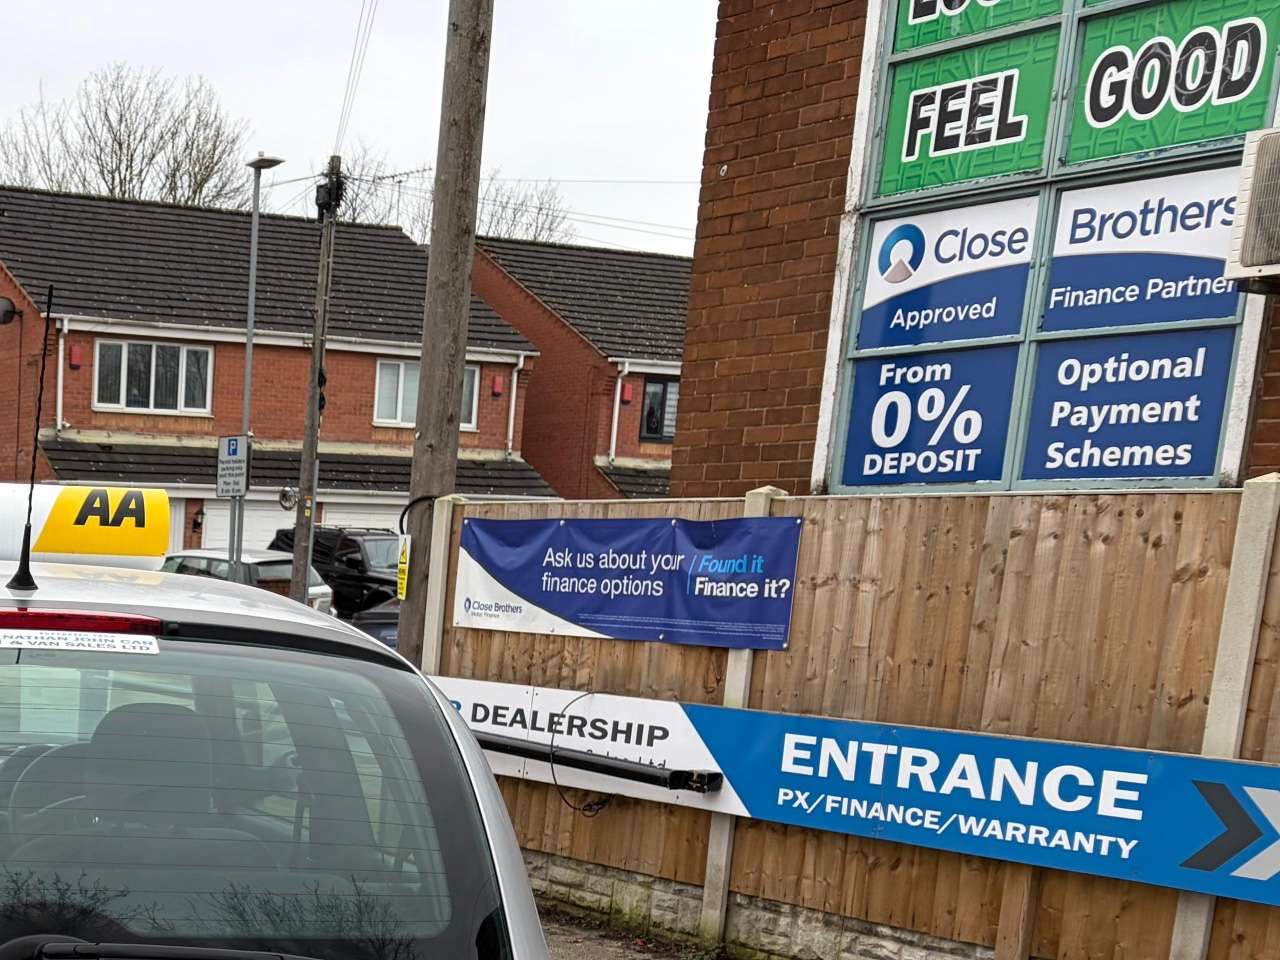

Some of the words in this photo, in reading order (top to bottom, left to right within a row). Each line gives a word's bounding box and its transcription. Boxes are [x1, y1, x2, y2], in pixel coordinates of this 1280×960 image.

[903, 71, 1026, 160] FEEL
[1087, 20, 1265, 125] GOOD
[933, 226, 1030, 264] Close
[1069, 195, 1237, 244] Brothers
[889, 296, 998, 330] Approved
[1048, 284, 1140, 309] Finance
[1145, 275, 1236, 300] Partner
[879, 362, 952, 386] From
[1057, 347, 1207, 391] Optional
[871, 384, 983, 449] 0%
[1050, 394, 1201, 433] Payment
[862, 448, 982, 476] DEPOSIT
[1045, 440, 1193, 469] Schemes
[73, 489, 146, 528] AA
[542, 547, 573, 568] Ask
[576, 552, 595, 568] us
[599, 548, 647, 570] about
[650, 553, 685, 574] your
[697, 555, 748, 573] Found
[751, 555, 765, 573] it
[541, 572, 597, 592] finance
[601, 574, 664, 598] options
[694, 576, 759, 597] Finance
[763, 578, 791, 598] it?
[472, 600, 493, 612] Close
[494, 602, 523, 614] Brothers
[65, 642, 117, 650] SALES
[121, 644, 151, 652] LTD
[470, 702, 670, 748] DEALERSHIP
[780, 732, 1149, 821] ENTRANCE
[777, 787, 1140, 860] PX/FINANCE/WARRANTY
